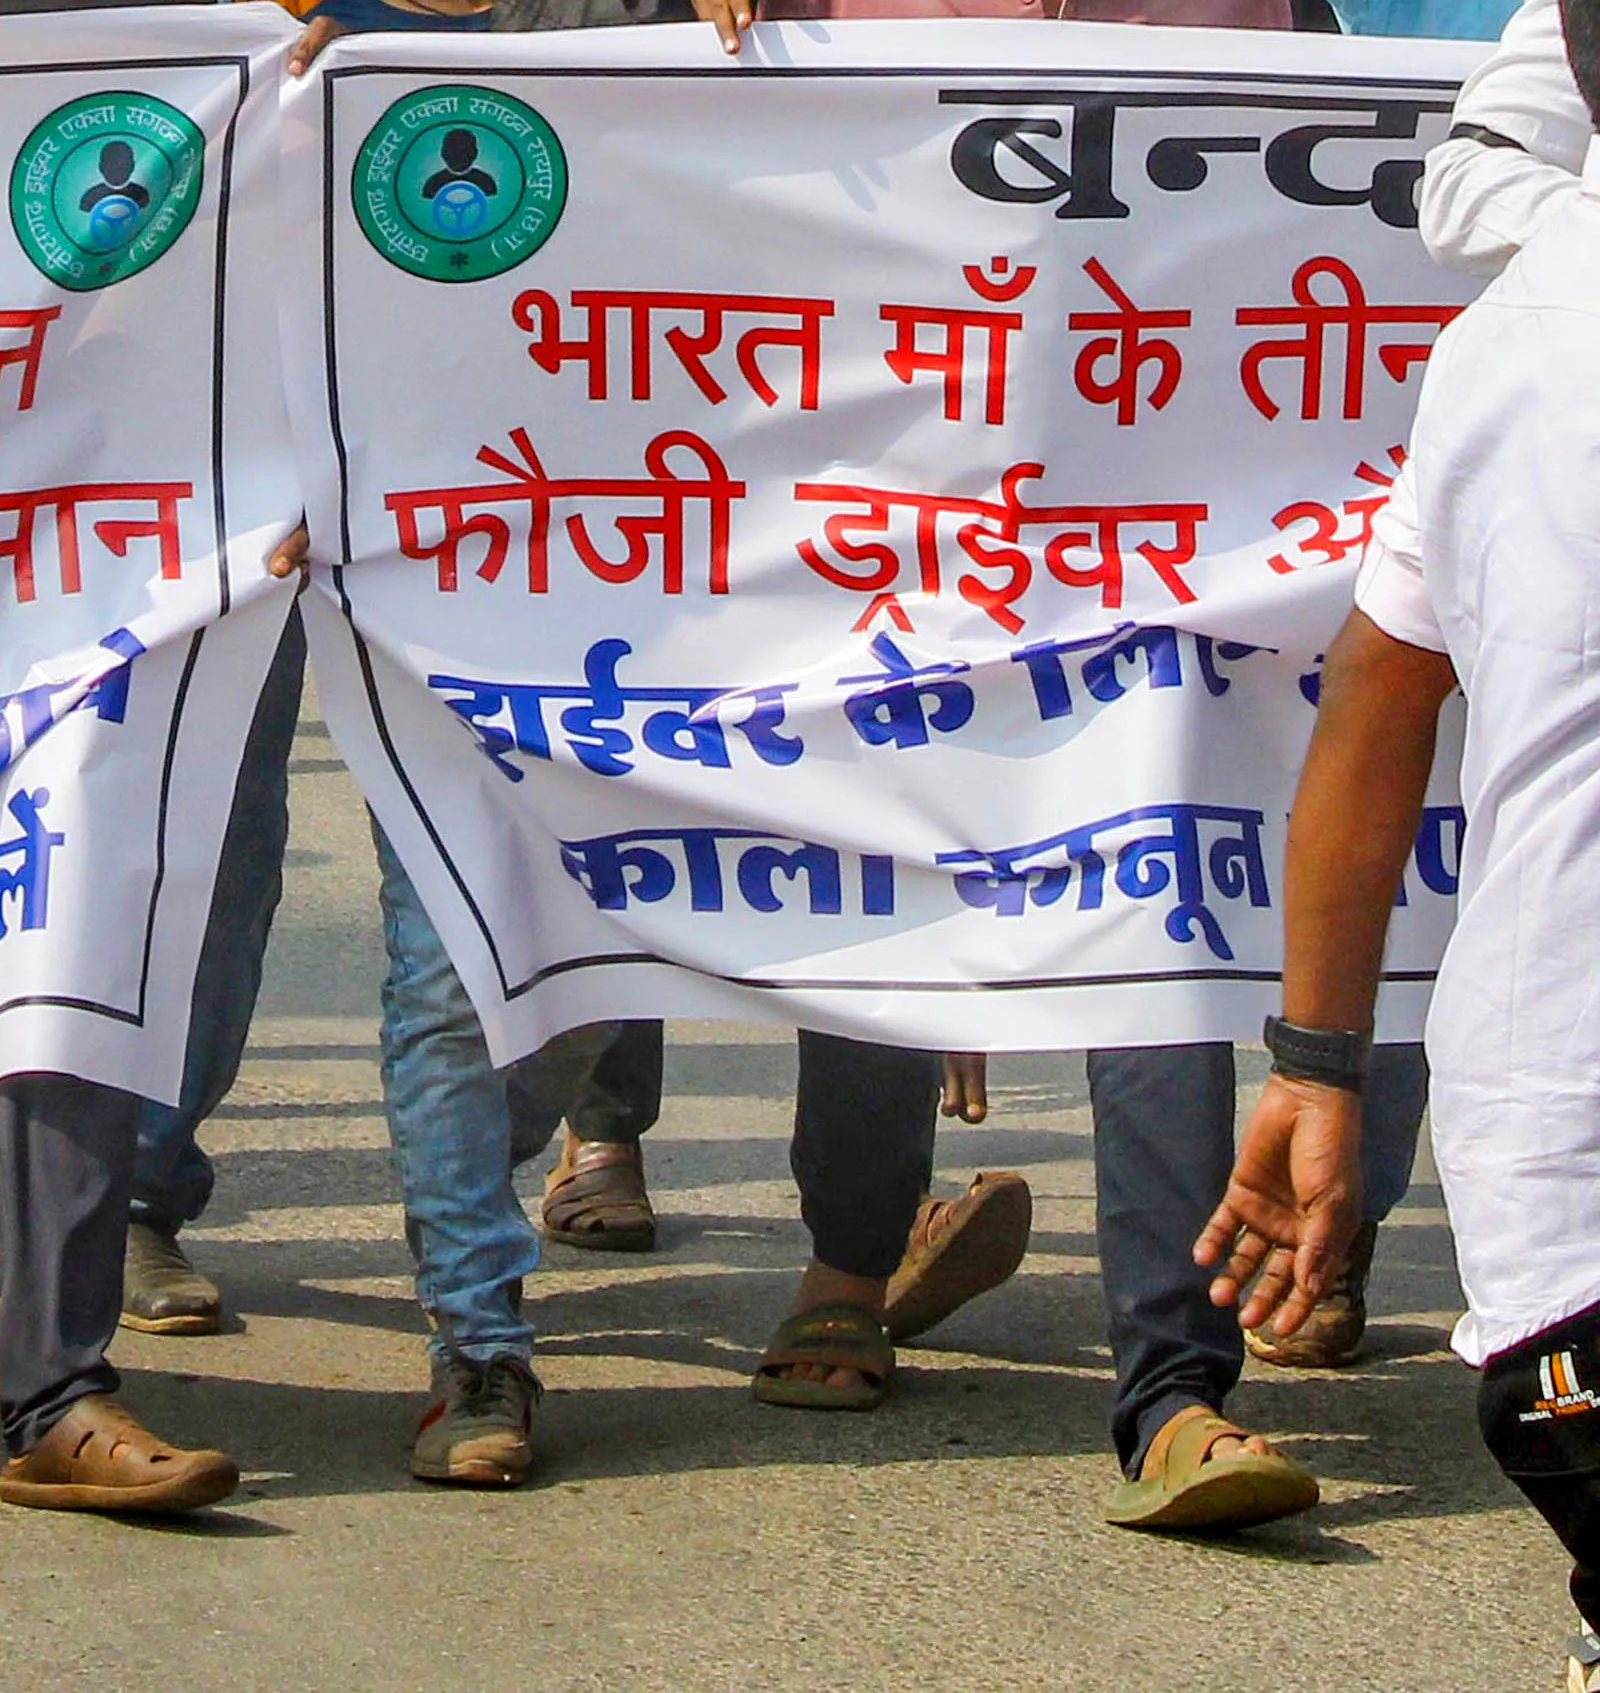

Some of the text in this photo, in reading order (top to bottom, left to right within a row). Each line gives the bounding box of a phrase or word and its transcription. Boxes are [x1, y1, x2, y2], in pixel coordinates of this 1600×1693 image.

[58, 105, 116, 139] एकता
[400, 96, 459, 127] एकता
[469, 95, 534, 137] संगठन
[512, 290, 834, 410] भारत
[880, 257, 1036, 425] माँ
[1069, 258, 1191, 425] के
[385, 428, 746, 594] फौजी
[795, 463, 1208, 633] ड्राईवर
[843, 630, 974, 750] के
[561, 829, 893, 915] काला
[936, 804, 1270, 960] कानून
